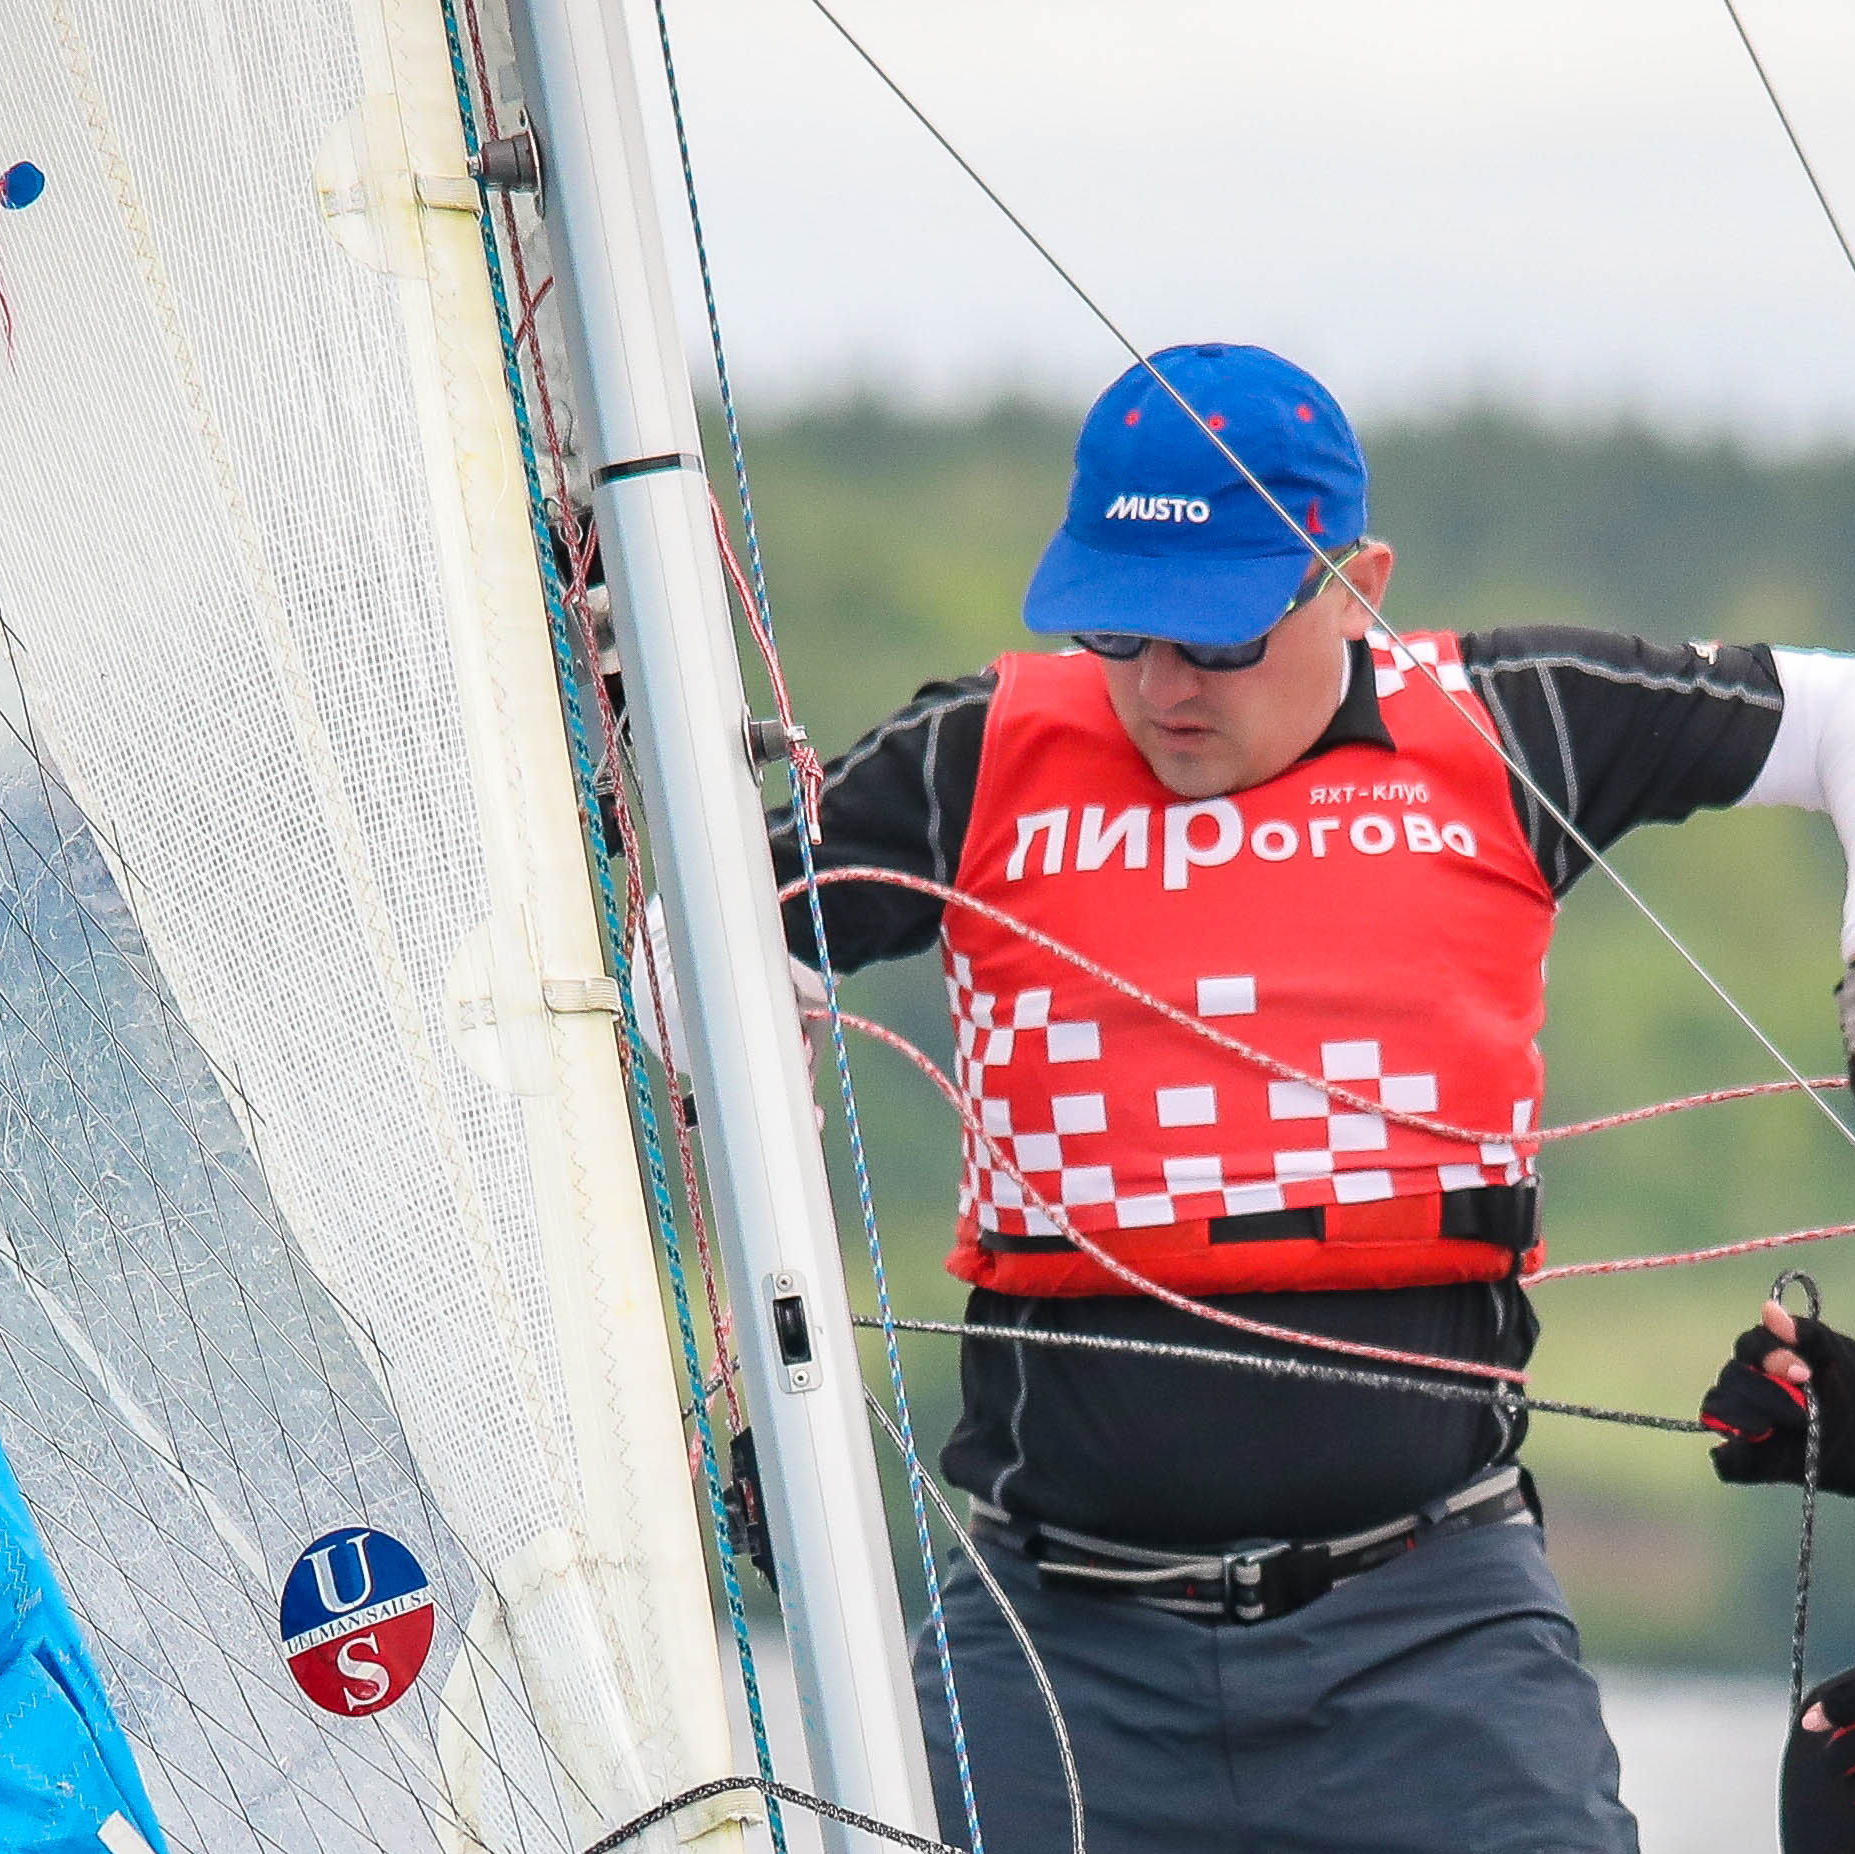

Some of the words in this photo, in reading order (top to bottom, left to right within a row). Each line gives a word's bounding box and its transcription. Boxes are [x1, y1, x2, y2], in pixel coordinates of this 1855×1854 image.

[1105, 493, 1210, 523] MUSTO
[304, 1532, 371, 1614] U
[336, 1632, 391, 1711] S
